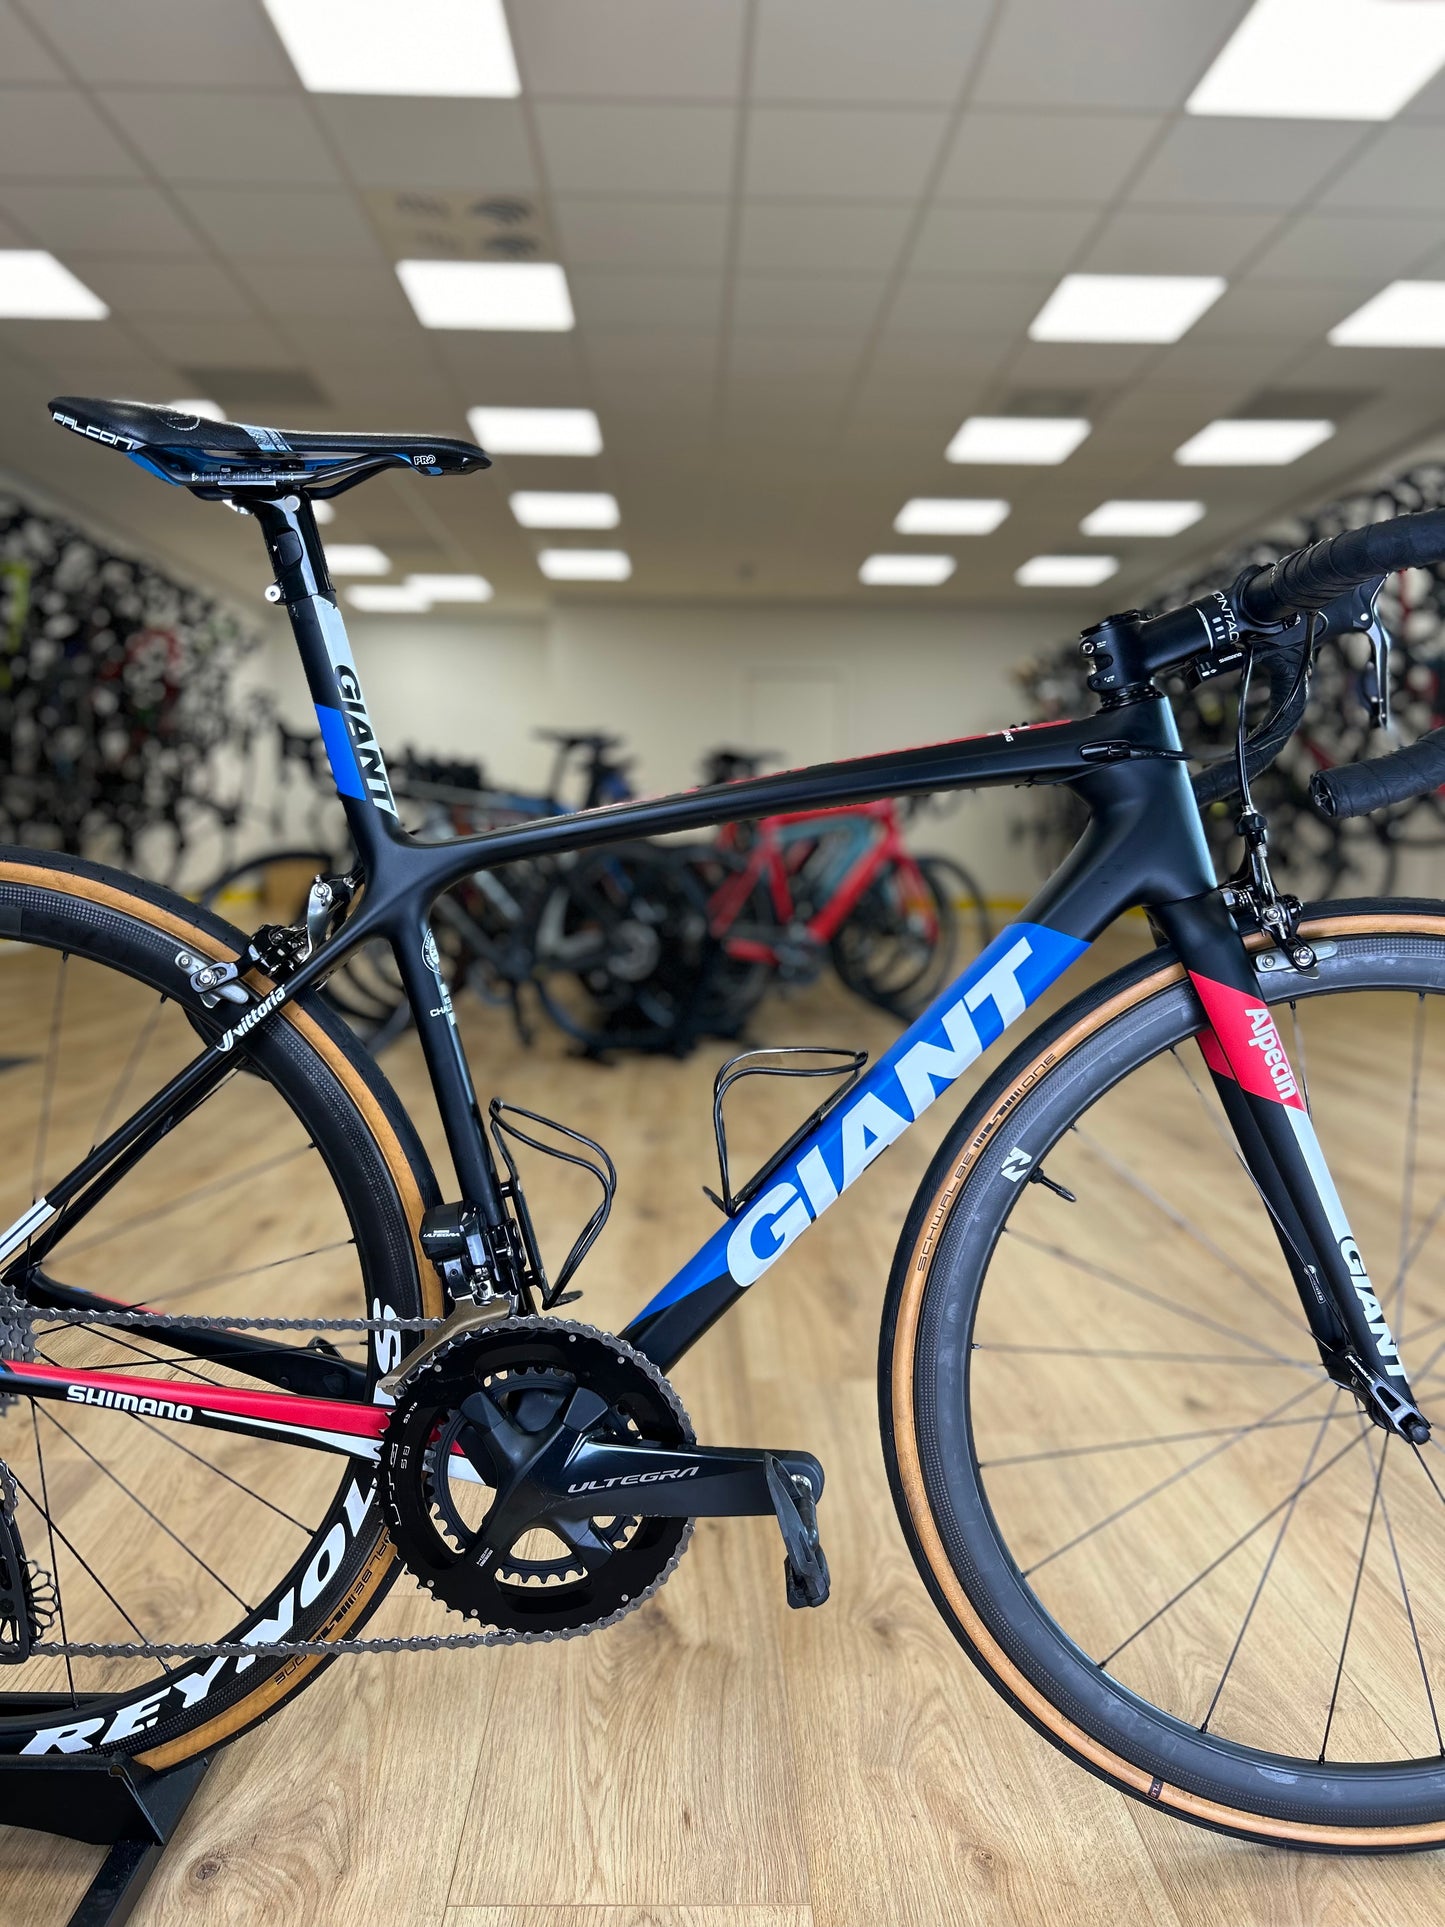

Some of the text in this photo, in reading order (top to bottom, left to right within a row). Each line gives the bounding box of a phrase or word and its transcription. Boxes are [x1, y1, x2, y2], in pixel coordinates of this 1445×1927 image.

[1211, 591, 1240, 642] ONTAC
[335, 664, 396, 812] GIANT
[727, 936, 1033, 1287] GIANT
[1245, 1008, 1297, 1100] Alpecin
[917, 1053, 1056, 1272] SCHWALBE ONE
[1340, 1238, 1409, 1384] GIANT
[66, 1384, 194, 1421] SHIMANO
[19, 1297, 402, 1755] REYNOLS
[568, 1466, 700, 1493] ULTEGRA
